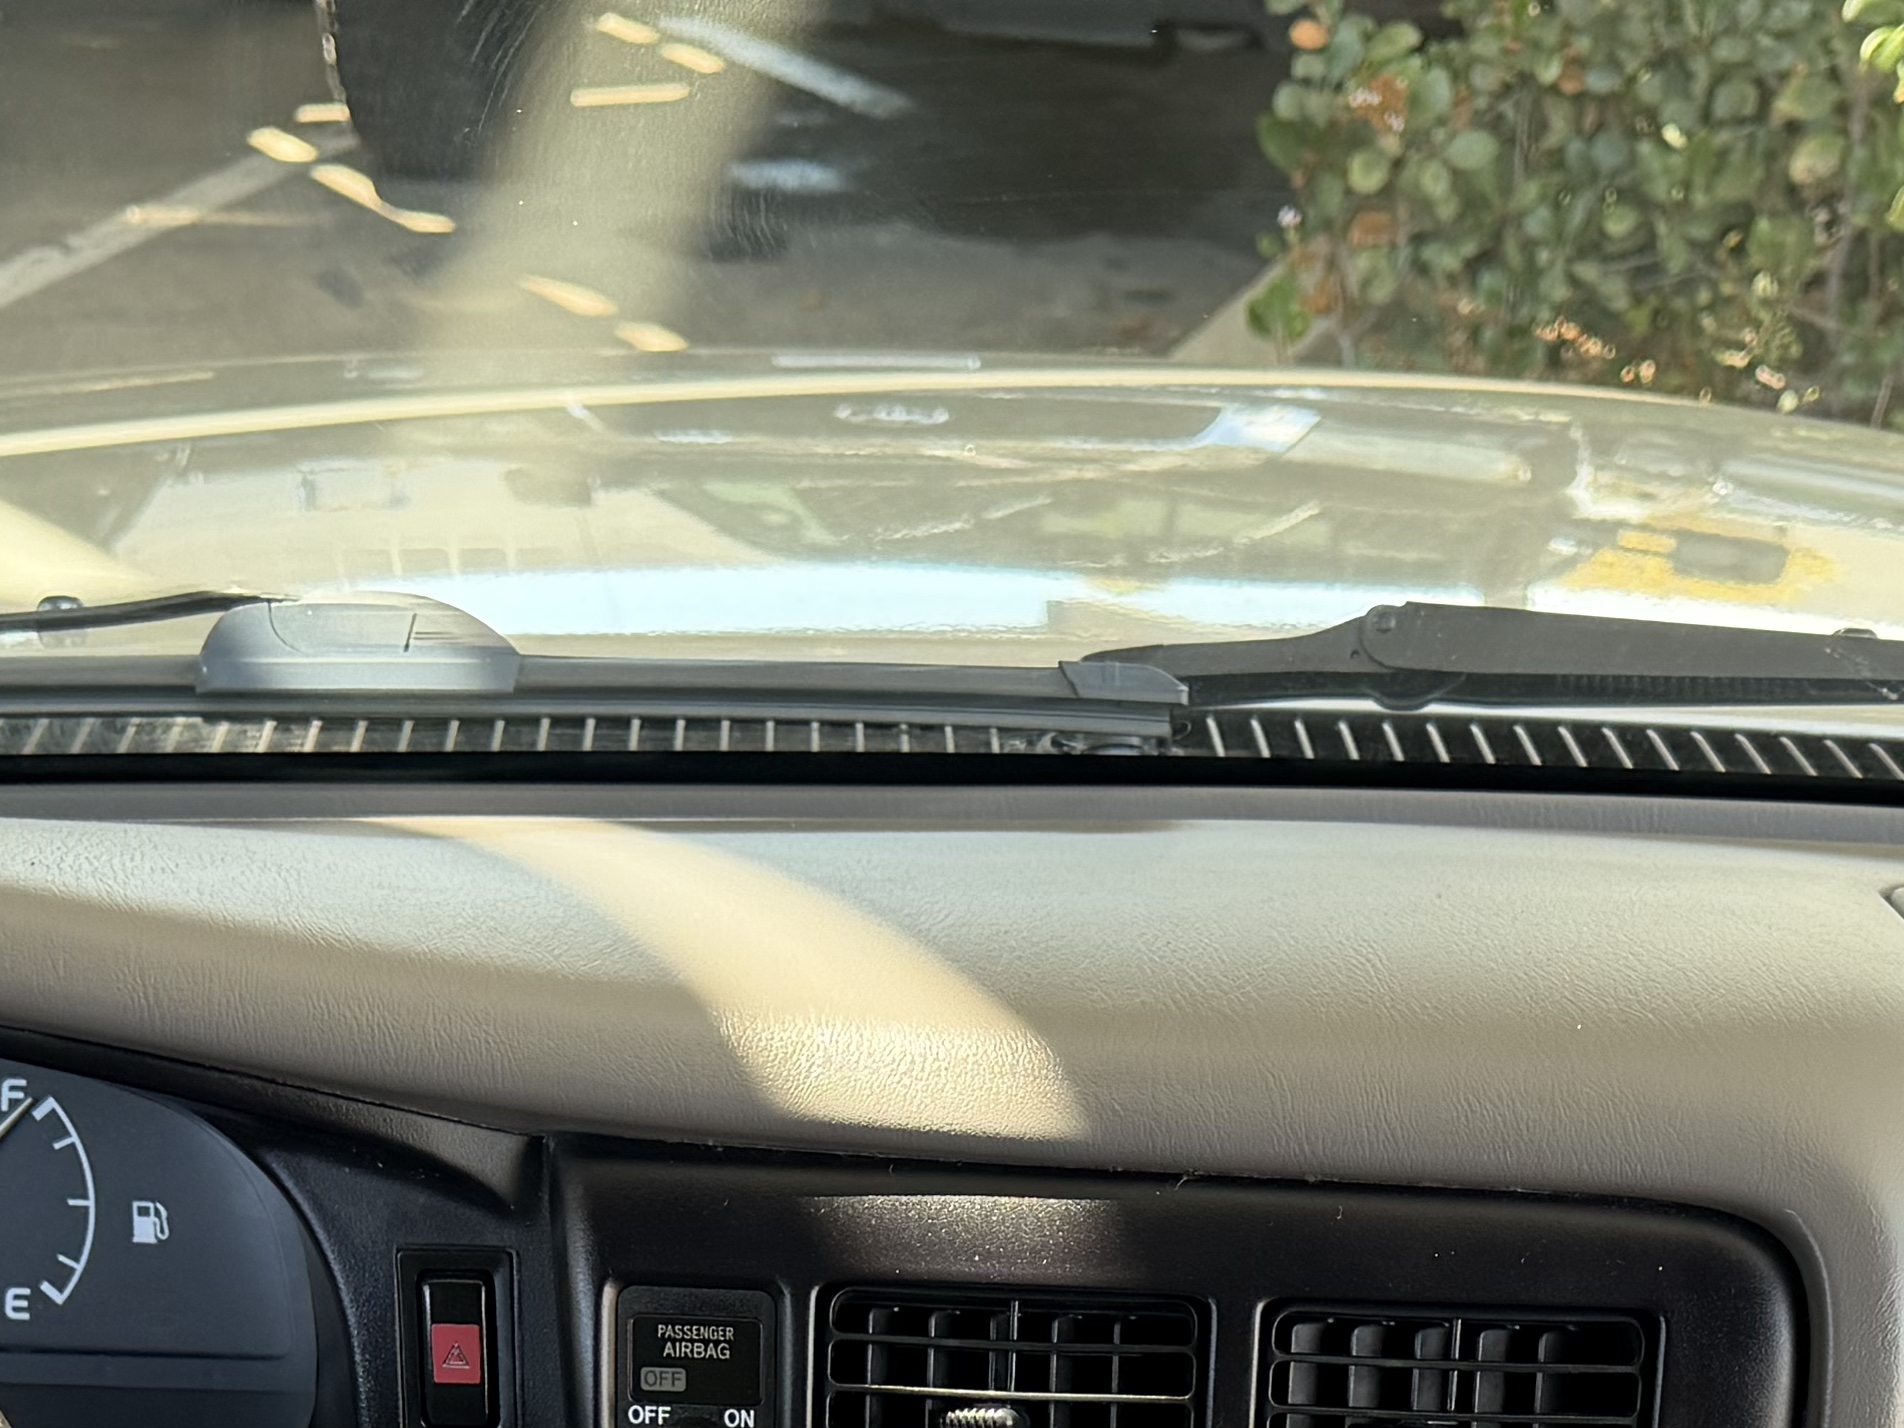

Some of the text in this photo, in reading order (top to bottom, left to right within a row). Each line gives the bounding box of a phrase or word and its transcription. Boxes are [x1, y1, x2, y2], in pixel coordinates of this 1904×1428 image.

[0, 1078, 28, 1112] F
[4, 1286, 32, 1321] E
[657, 1323, 735, 1341] PASSENGER
[662, 1341, 731, 1360] AIRBAG
[644, 1369, 683, 1388] OFF
[627, 1404, 756, 1428] OFF ON
